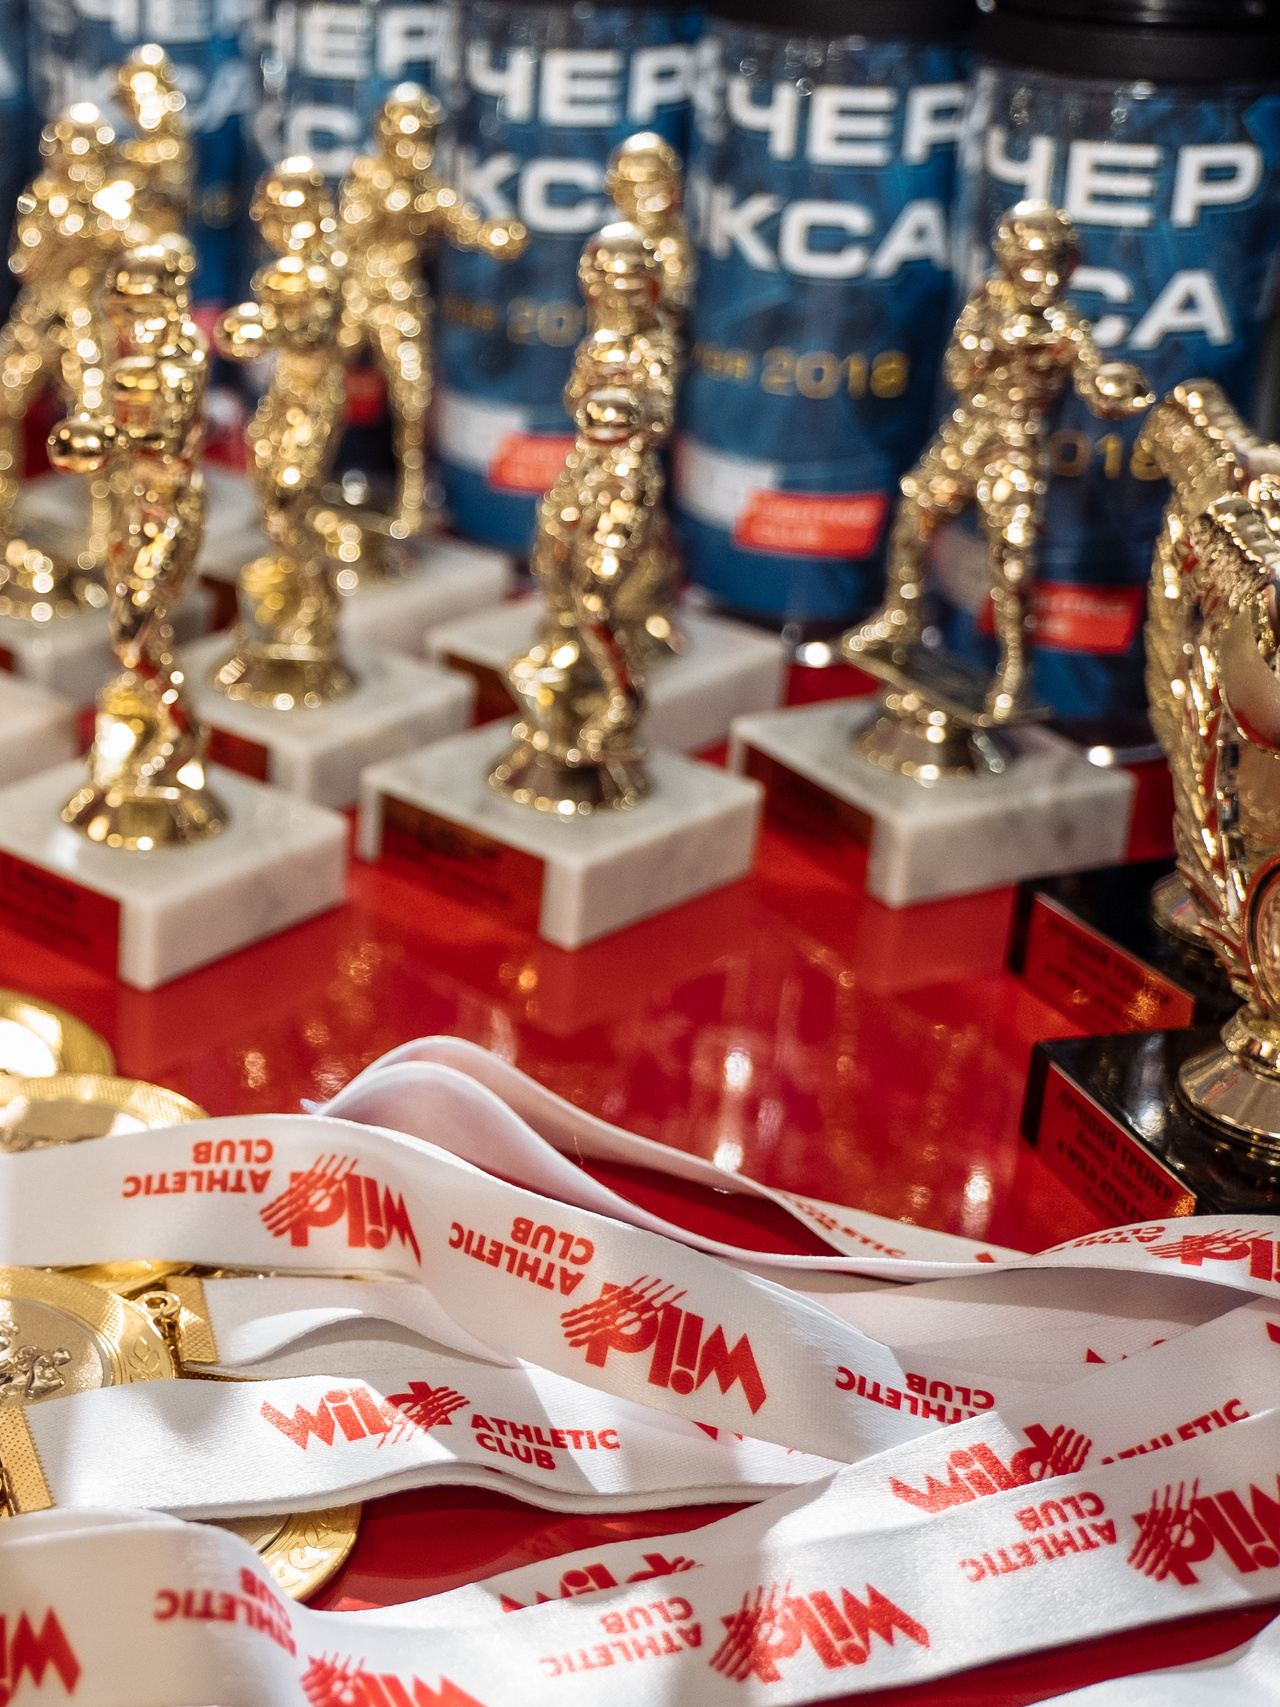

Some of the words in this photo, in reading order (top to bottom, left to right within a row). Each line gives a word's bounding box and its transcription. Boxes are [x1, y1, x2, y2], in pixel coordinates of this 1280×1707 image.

[455, 149, 604, 235] КС
[985, 125, 1265, 228] ЧЕР
[505, 297, 588, 348] 20
[1068, 266, 1235, 351] СА
[759, 345, 910, 400] 2018
[1046, 428, 1170, 482] 018
[192, 1138, 274, 1165] CLUB
[122, 1169, 273, 1198] ATHLETIC
[1097, 1177, 1148, 1222] ATHLET
[448, 1221, 585, 1296] ATHLETIC
[510, 1216, 595, 1266] CLUB
[1144, 1228, 1280, 1284] ld
[834, 1365, 979, 1426] THLETIC
[905, 1372, 995, 1410] CLUB
[471, 1413, 621, 1450] ATHLETIC
[475, 1432, 557, 1471] CLUB
[1102, 1398, 1250, 1466] ETIC
[1014, 1491, 1105, 1533] CLUB
[959, 1518, 1117, 1583] ATHLETIC
[599, 1596, 694, 1635] CLUB
[538, 1621, 703, 1678] ATHLETIC
